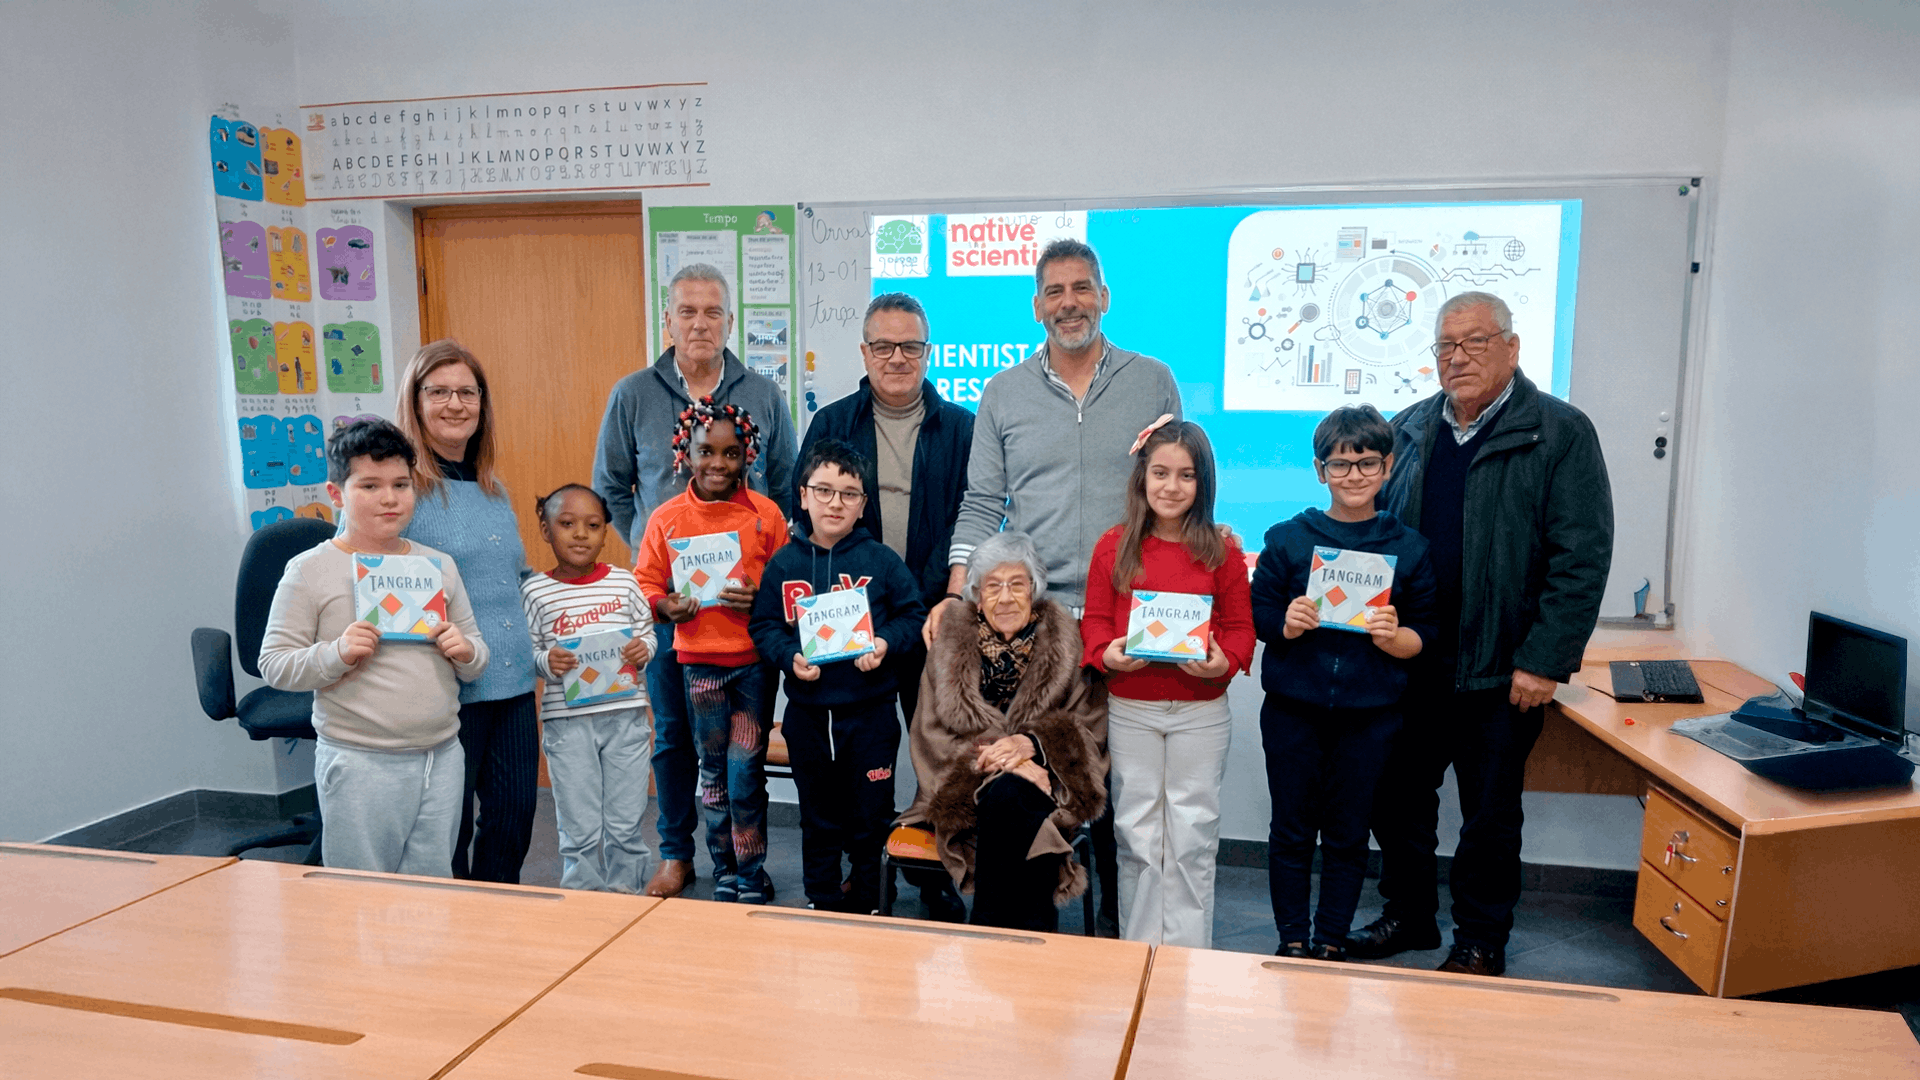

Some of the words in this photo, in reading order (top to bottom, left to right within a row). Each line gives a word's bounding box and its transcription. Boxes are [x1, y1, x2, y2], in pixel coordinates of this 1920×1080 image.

[331, 118, 337, 127] a
[343, 112, 350, 126] b
[355, 116, 362, 125] c
[369, 111, 376, 124] d
[384, 114, 391, 123] e
[399, 110, 405, 122] f
[412, 113, 421, 125] g
[427, 109, 434, 121] h
[457, 107, 461, 123] j
[469, 105, 477, 119] k
[497, 108, 509, 117] m
[514, 108, 522, 117] n
[528, 107, 537, 116] o
[543, 107, 551, 119] p
[558, 106, 566, 118] q
[574, 104, 580, 113] r
[589, 104, 596, 113] s
[604, 101, 610, 112] t
[619, 102, 626, 111] u
[634, 101, 642, 111] v
[647, 100, 658, 110] w
[664, 99, 671, 109] x
[679, 98, 687, 111] y
[695, 98, 702, 107] z
[333, 158, 341, 170] A
[346, 157, 353, 169] B
[357, 156, 366, 169] C
[371, 155, 380, 168] D
[386, 155, 394, 168] E
[401, 154, 408, 167] F
[414, 153, 423, 166] G
[428, 153, 437, 166] H
[458, 152, 464, 164] J
[472, 151, 481, 164] K
[487, 151, 494, 163] L
[500, 150, 511, 162] M
[516, 149, 525, 162] N
[529, 148, 540, 161] O
[545, 148, 553, 160] P
[559, 147, 569, 162] Q
[575, 146, 583, 159] R
[590, 145, 598, 158] S
[604, 144, 613, 157] T
[619, 144, 629, 157] U
[635, 143, 644, 156] V
[648, 142, 661, 156] W
[665, 142, 674, 155] X
[680, 140, 689, 154] Y
[696, 140, 705, 153] Z
[703, 212, 738, 227] Tempo
[951, 217, 1036, 242] native
[951, 243, 1041, 267] scienti
[680, 550, 734, 571] TANGRAM
[369, 575, 434, 592] TANGRAM
[1322, 568, 1384, 588] TANGRAM
[807, 604, 861, 626] TANGRAM
[1141, 606, 1202, 621] TANGRAM
[578, 646, 625, 664] ANGRA
